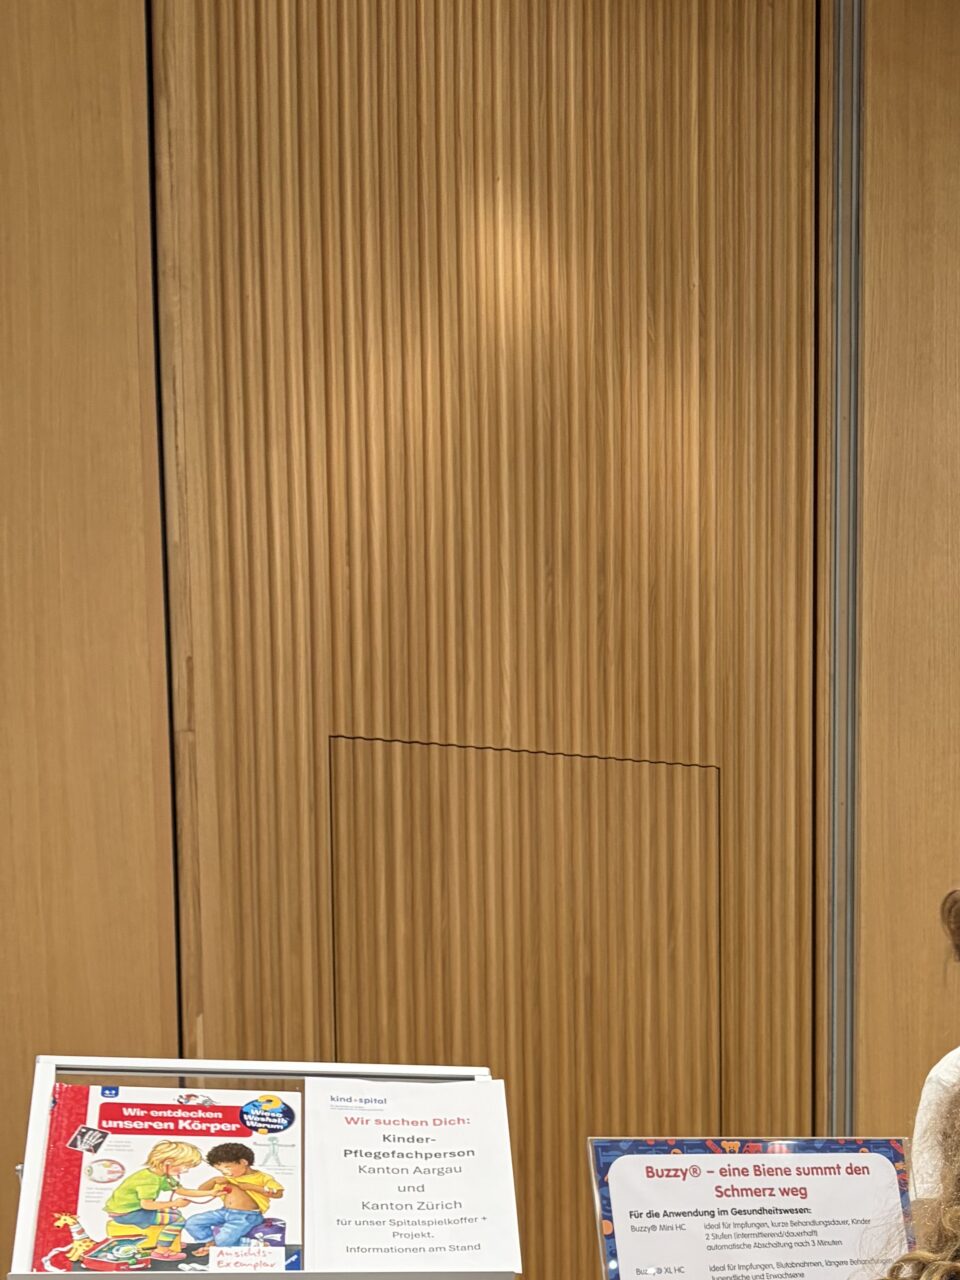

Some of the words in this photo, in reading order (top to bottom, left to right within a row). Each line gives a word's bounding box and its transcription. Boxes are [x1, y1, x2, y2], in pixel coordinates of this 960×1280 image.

[122, 1107, 147, 1117] Wir
[150, 1108, 222, 1119] entdecken
[250, 1108, 283, 1118] Wieso
[243, 1114, 288, 1125] Weshalb
[246, 1120, 284, 1130] Warum
[344, 1116, 371, 1126] Wir
[374, 1117, 429, 1127] suchen
[432, 1116, 471, 1127] Dich:
[101, 1119, 174, 1130] unseren
[178, 1119, 241, 1133] Körper
[382, 1134, 437, 1144] Kinder-
[343, 1149, 476, 1161] Pflegefachperson
[358, 1165, 409, 1175] Kanton
[412, 1165, 463, 1177] Aargau
[645, 1164, 702, 1181] Buzzy®
[719, 1164, 750, 1177] eine
[752, 1164, 792, 1177] Biene
[795, 1164, 842, 1177] summt
[845, 1162, 871, 1176] den
[397, 1184, 426, 1193] und
[714, 1184, 776, 1198] Schmerz
[778, 1186, 808, 1200] weg
[361, 1201, 413, 1211] Kanton
[416, 1200, 463, 1211] Zürich
[629, 1210, 643, 1219] Für
[645, 1209, 661, 1219] die
[662, 1208, 716, 1219] Anwendung
[717, 1207, 729, 1216] im
[730, 1206, 812, 1216] Gesundheitswesen:
[336, 1218, 352, 1226] für
[388, 1216, 479, 1227] Spitalspielkoffer
[704, 1221, 721, 1230] ideal
[722, 1221, 731, 1229] für
[732, 1220, 770, 1231] Impfungen,
[770, 1220, 789, 1228] kurze
[851, 1218, 871, 1226] Kinder
[659, 1224, 674, 1232] Mini
[675, 1223, 687, 1232] HC
[392, 1231, 435, 1240] Projekt.
[705, 1232, 710, 1241] 2
[711, 1232, 733, 1241] Stufen
[346, 1245, 426, 1254] Informationen
[448, 1243, 481, 1252] Stand
[706, 1242, 752, 1252] automatische
[753, 1240, 794, 1250] Abschaltung
[794, 1240, 811, 1248] nach
[811, 1239, 816, 1247] 3
[817, 1239, 843, 1247] Minuten
[664, 1266, 673, 1274] XL
[673, 1266, 685, 1274] HC
[709, 1264, 726, 1272] ideal
[727, 1263, 737, 1271] für
[737, 1261, 775, 1272] Impfungen,
[752, 1273, 765, 1280] und
[766, 1272, 805, 1280] Erwachsene
